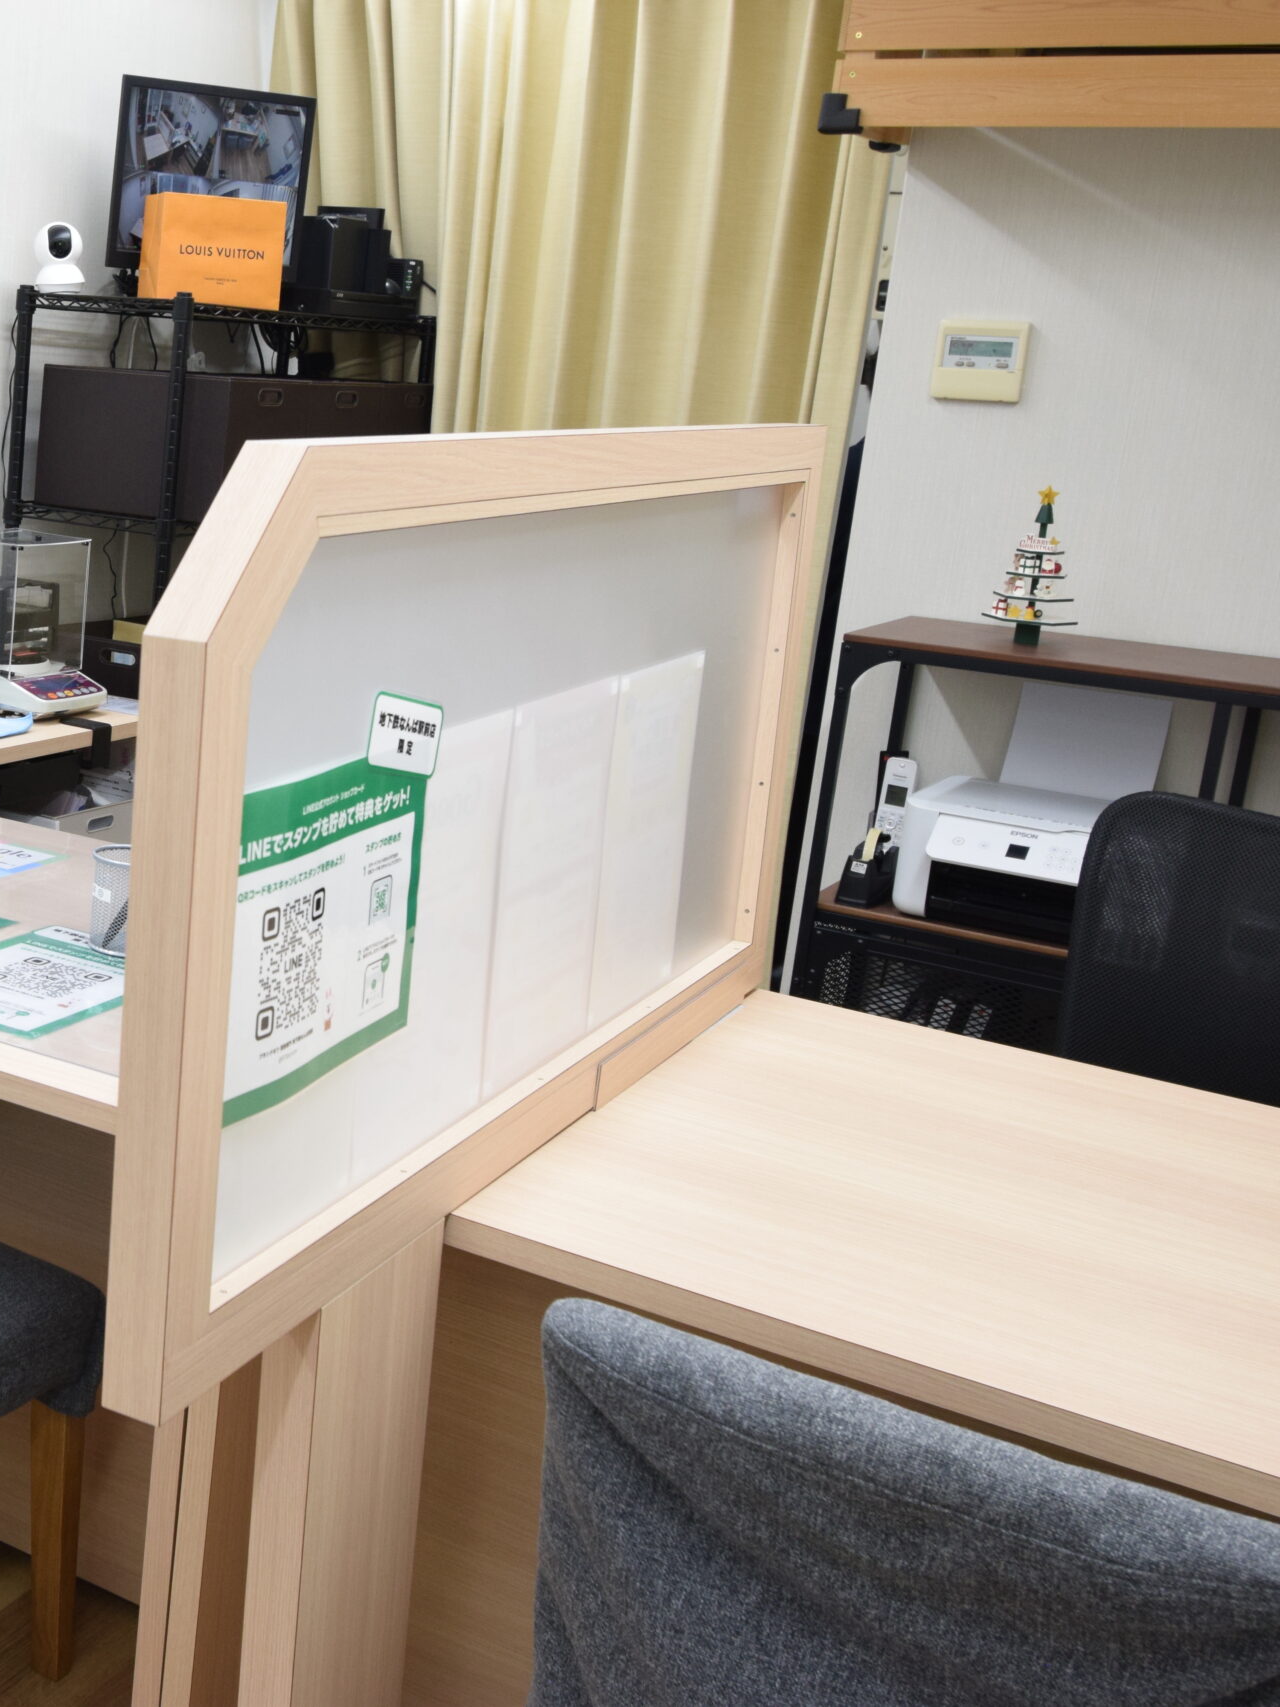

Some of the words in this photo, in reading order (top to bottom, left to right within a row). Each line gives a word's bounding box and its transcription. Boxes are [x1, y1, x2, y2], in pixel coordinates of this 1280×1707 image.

[179, 244, 213, 257] LOUIS
[216, 247, 265, 261] VUITTON
[378, 712, 437, 738] 地下鉄なんば駅前店
[239, 785, 411, 865] LINEでスタンプを貯めて特典をゲット!
[1009, 829, 1039, 840] EPSON
[283, 953, 304, 974] LINE
